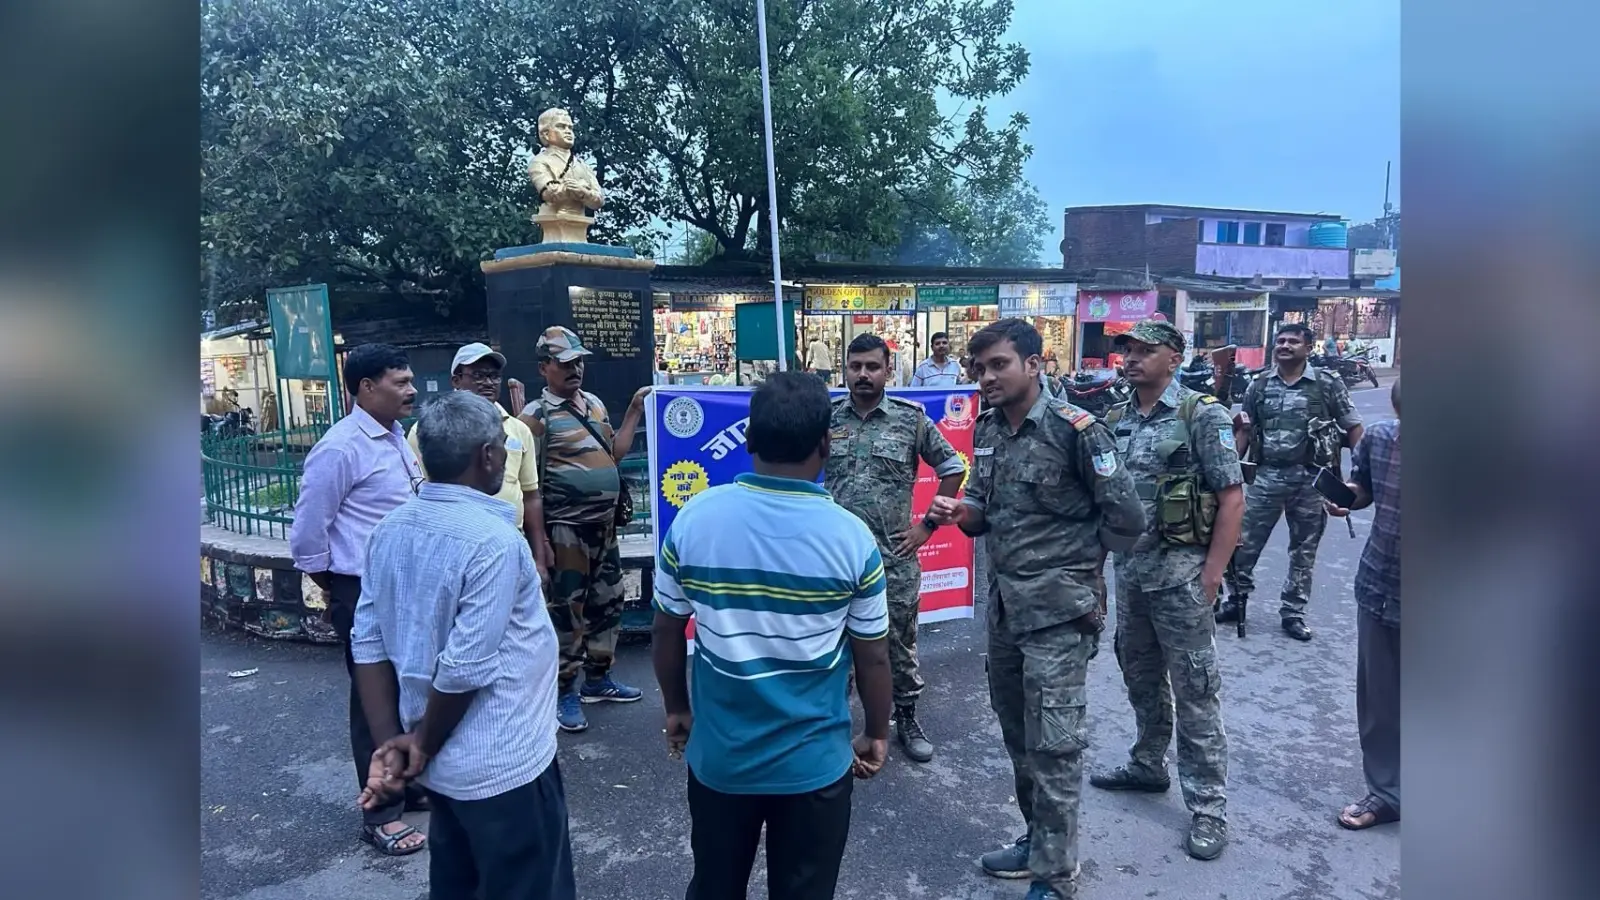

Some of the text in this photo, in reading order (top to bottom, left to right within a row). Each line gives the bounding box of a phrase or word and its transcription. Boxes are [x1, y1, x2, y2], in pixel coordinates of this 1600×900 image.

[810, 288, 842, 296] GOLDEN
[844, 288, 878, 296] OPTICAL
[879, 288, 884, 296] &
[886, 288, 911, 296] WATCH
[1040, 298, 1061, 309] Clinic
[670, 470, 700, 481] नशे को
[676, 481, 692, 491] कहें
